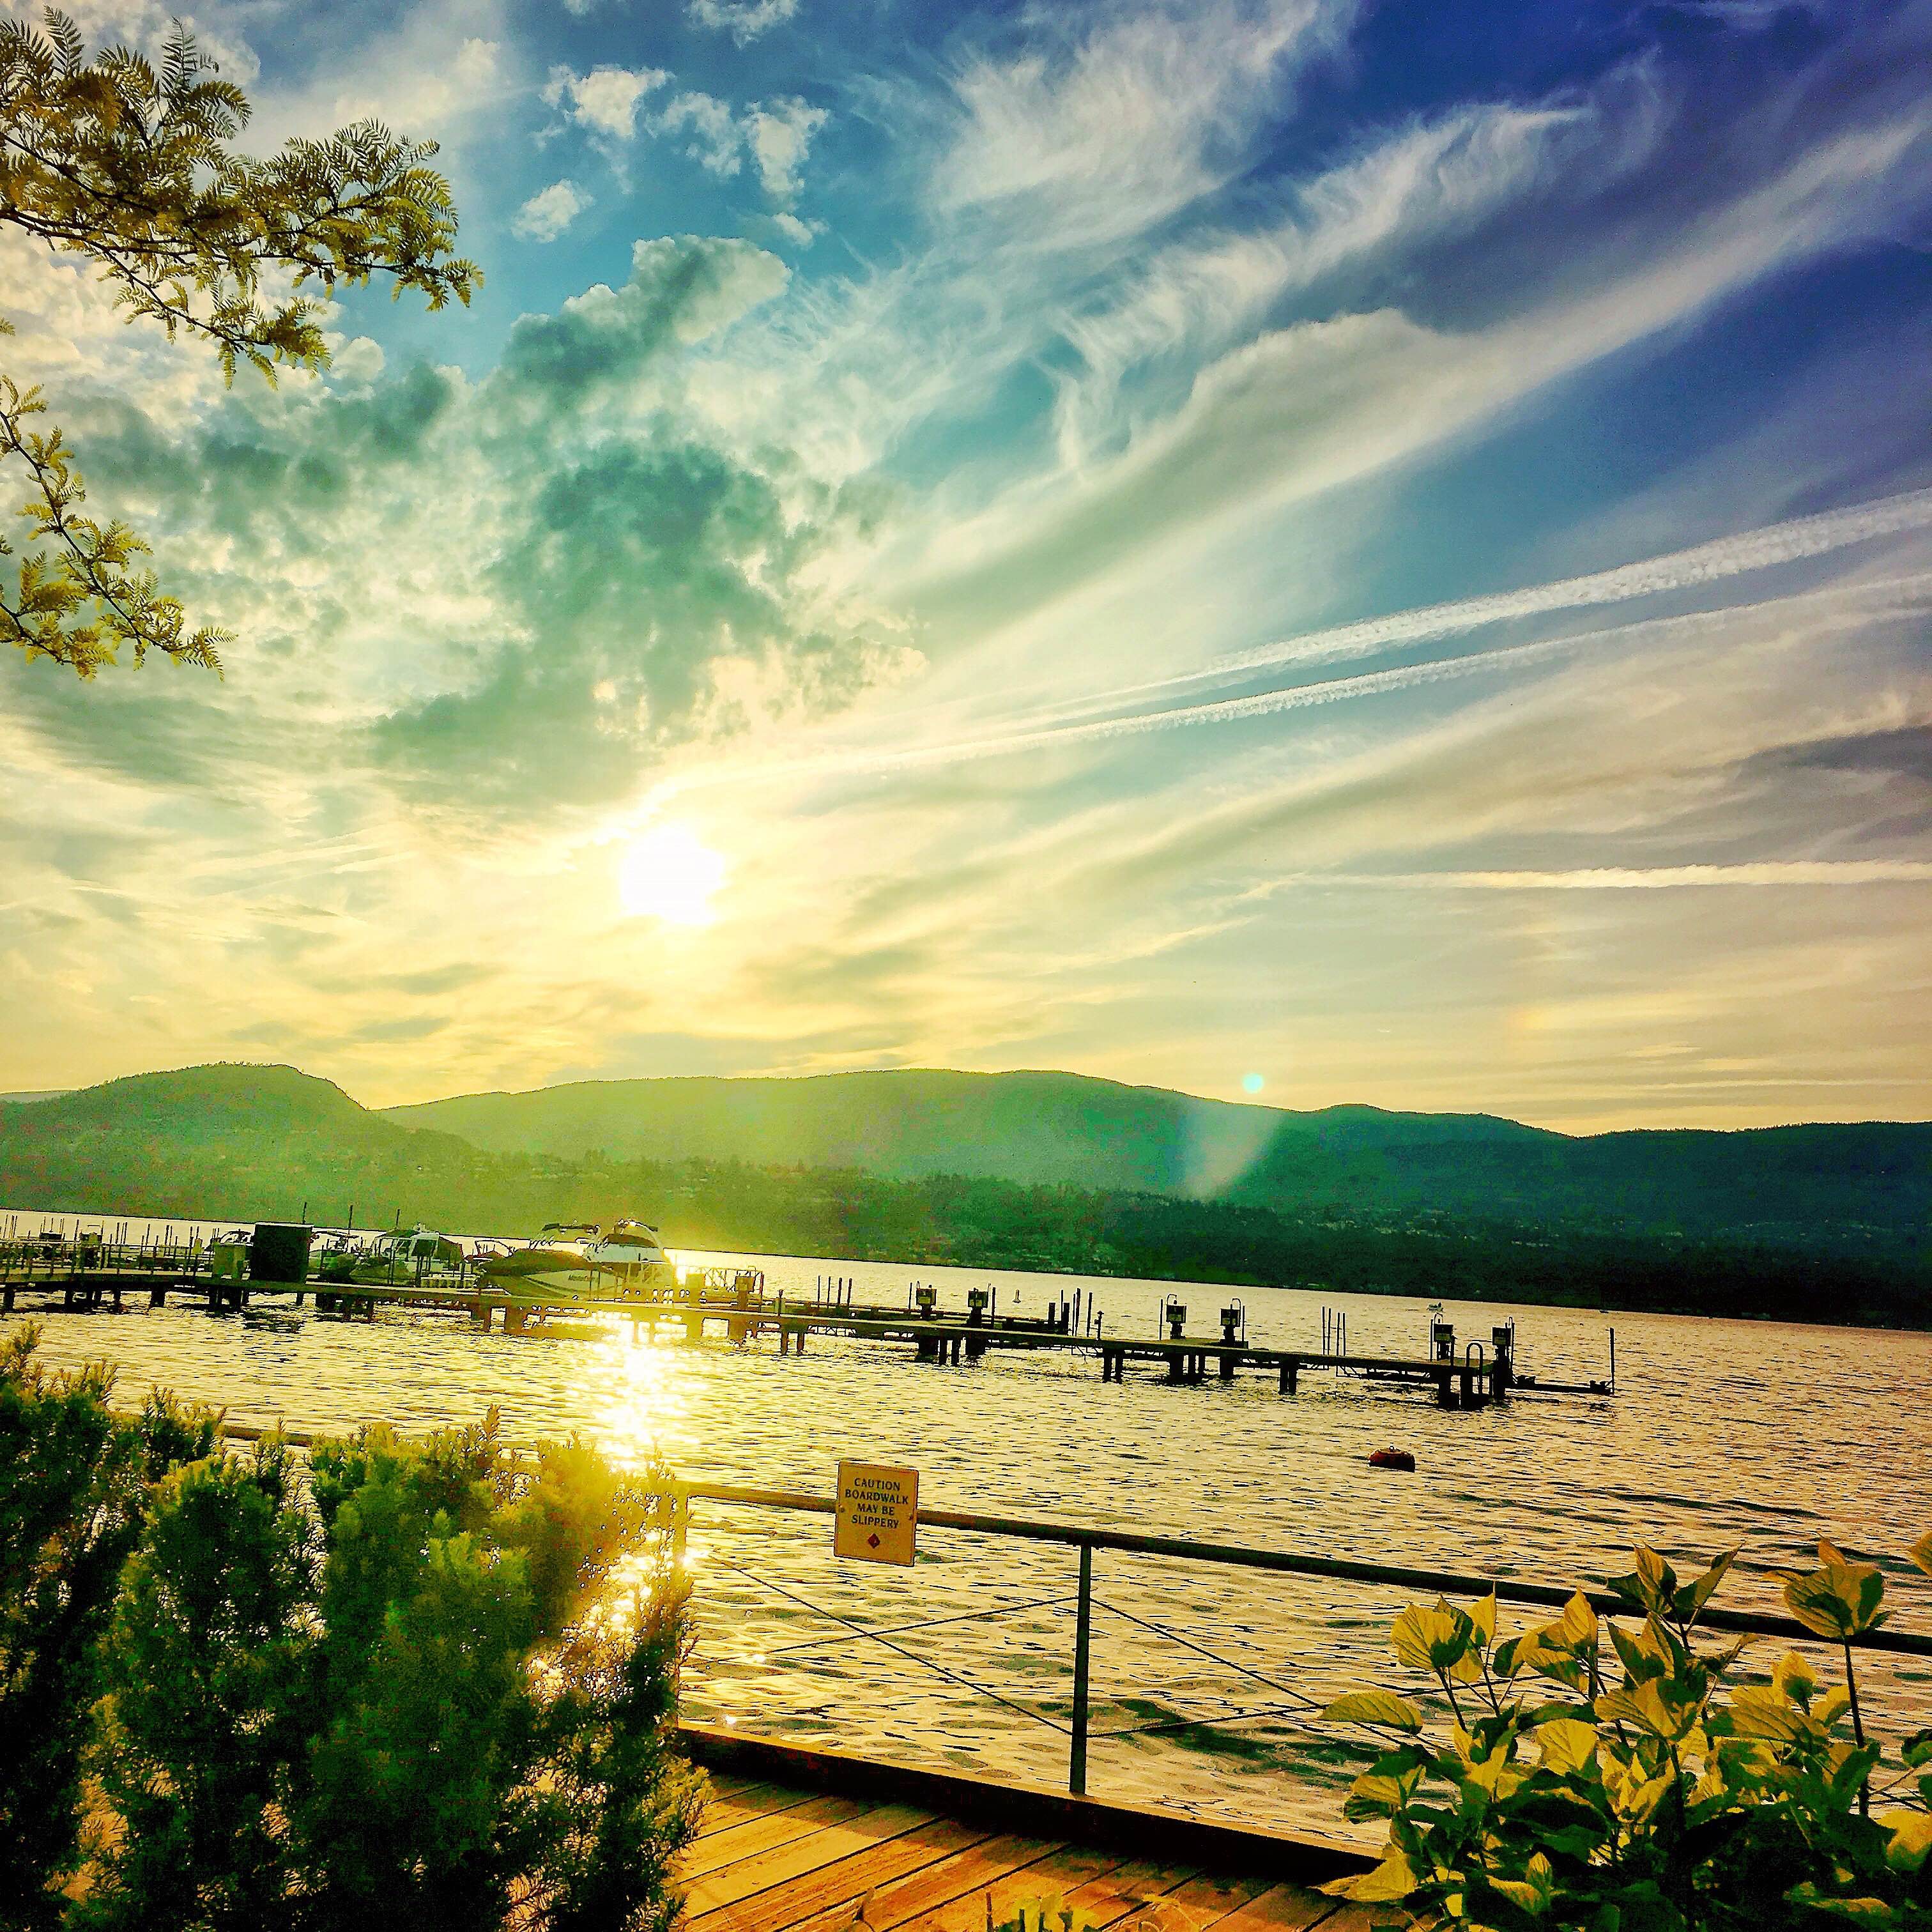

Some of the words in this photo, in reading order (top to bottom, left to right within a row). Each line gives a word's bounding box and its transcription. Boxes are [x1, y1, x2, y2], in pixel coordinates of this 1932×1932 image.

[854, 1478, 900, 1491] CAUTION
[845, 1489, 908, 1504] BOARDWALK
[857, 1503, 878, 1514] MAY
[882, 1506, 895, 1515] BE
[852, 1515, 899, 1529] SLIPPERY
